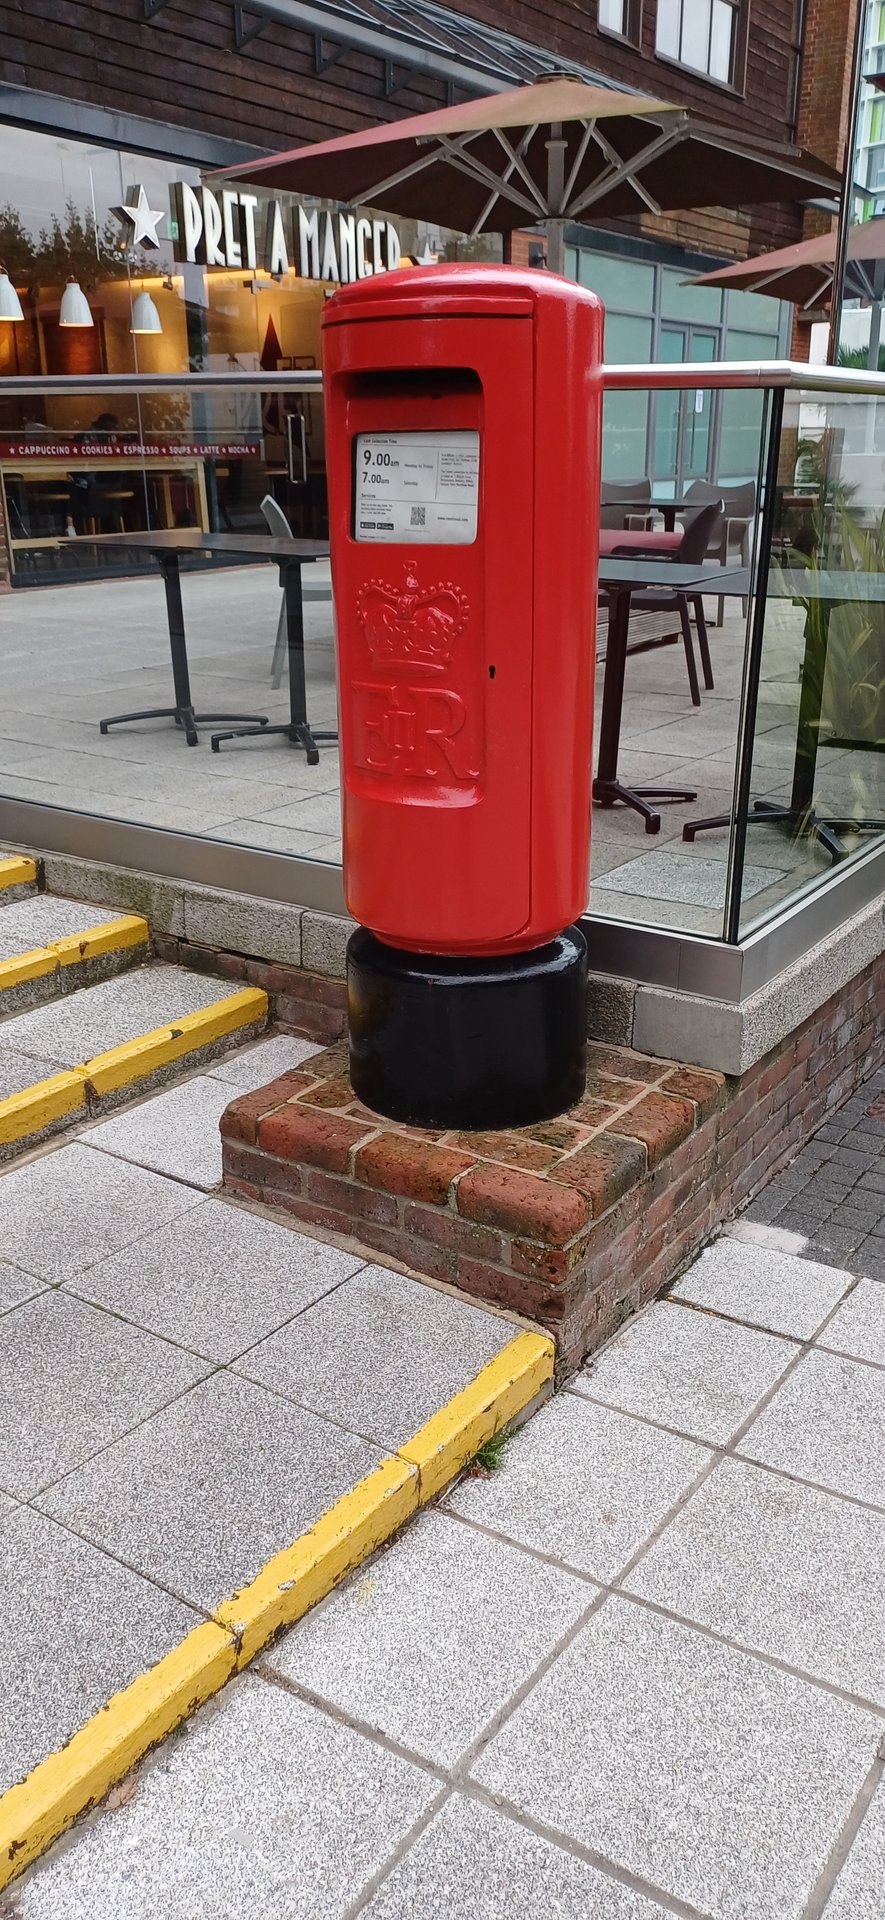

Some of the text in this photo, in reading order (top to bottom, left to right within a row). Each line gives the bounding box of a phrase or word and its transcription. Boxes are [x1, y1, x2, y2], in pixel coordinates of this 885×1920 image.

[169, 181, 257, 269] PRET
[265, 200, 288, 274] A
[18, 446, 70, 455] CAPPUCCINO
[81, 446, 113, 455] COOKIES
[123, 446, 159, 455] ESPRESSO
[200, 446, 219, 454] LATTE
[363, 449, 399, 467] 9.00am
